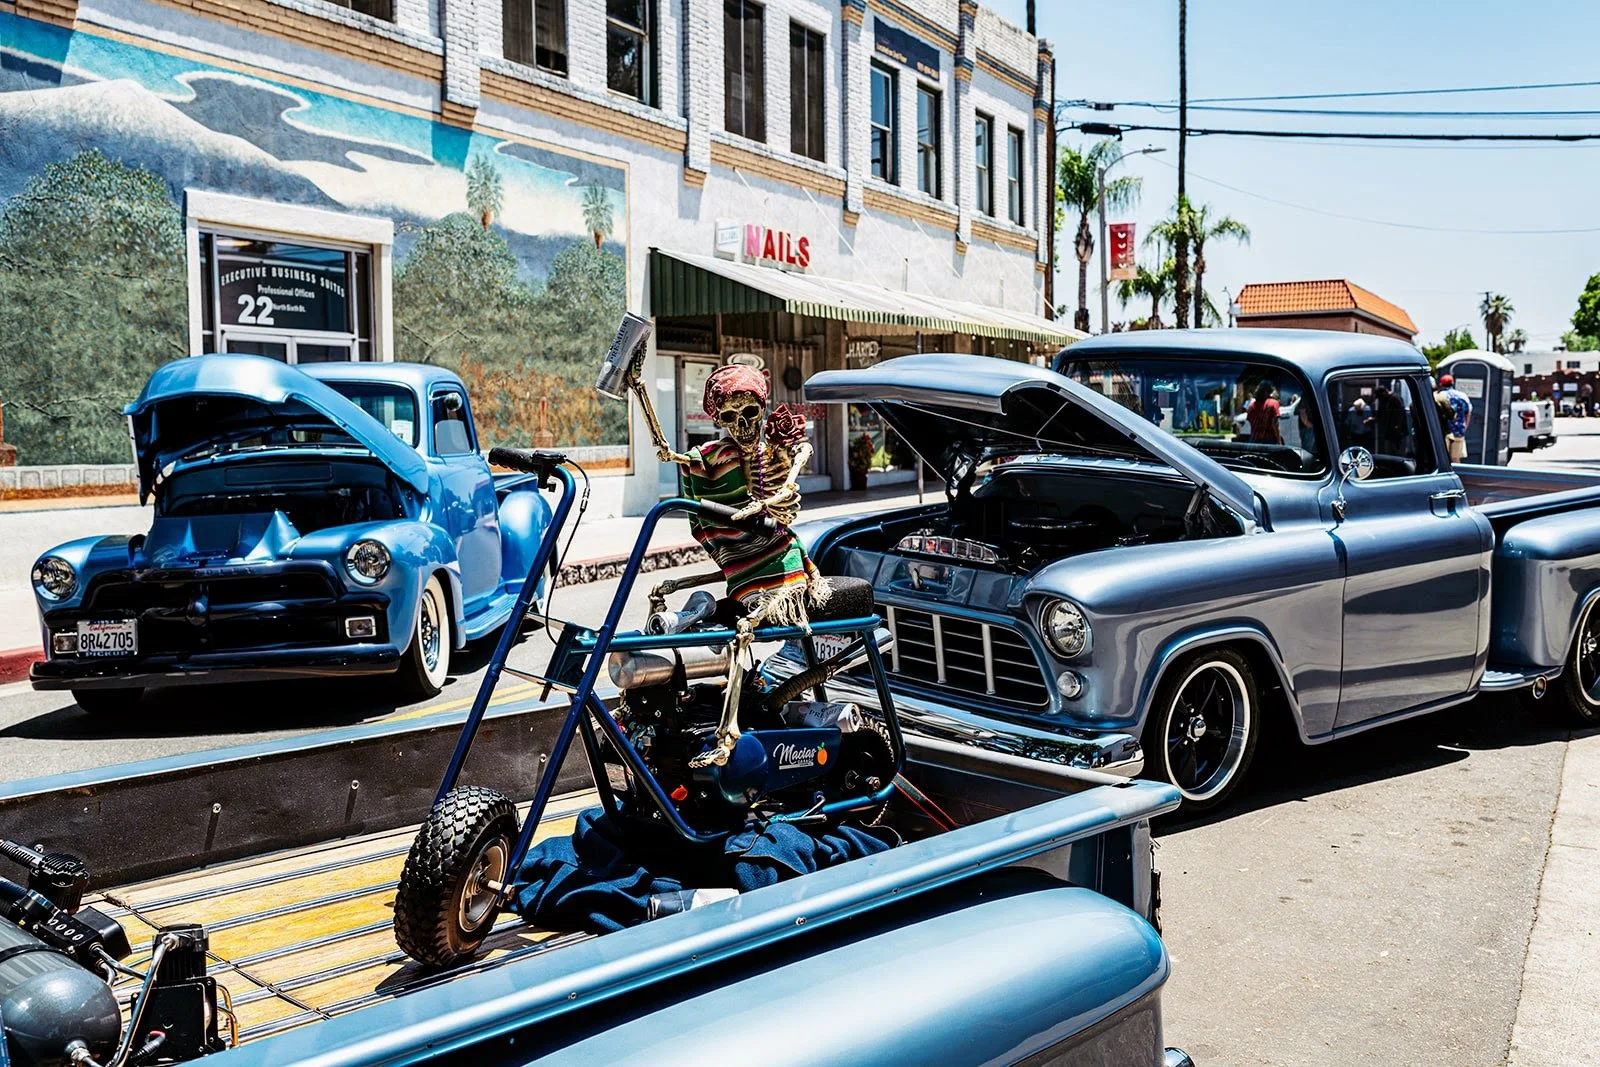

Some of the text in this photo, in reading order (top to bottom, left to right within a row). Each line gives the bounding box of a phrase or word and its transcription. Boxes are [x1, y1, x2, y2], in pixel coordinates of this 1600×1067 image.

[746, 223, 811, 268] NAILS
[221, 266, 345, 298] EXECUTIVE BUSINESS SUITES
[257, 284, 315, 299] Professional Offices
[237, 294, 274, 325] 22
[609, 319, 629, 363] PREMIER
[80, 632, 134, 650] 8R42705
[89, 625, 125, 633] California
[773, 742, 817, 765] Macias
